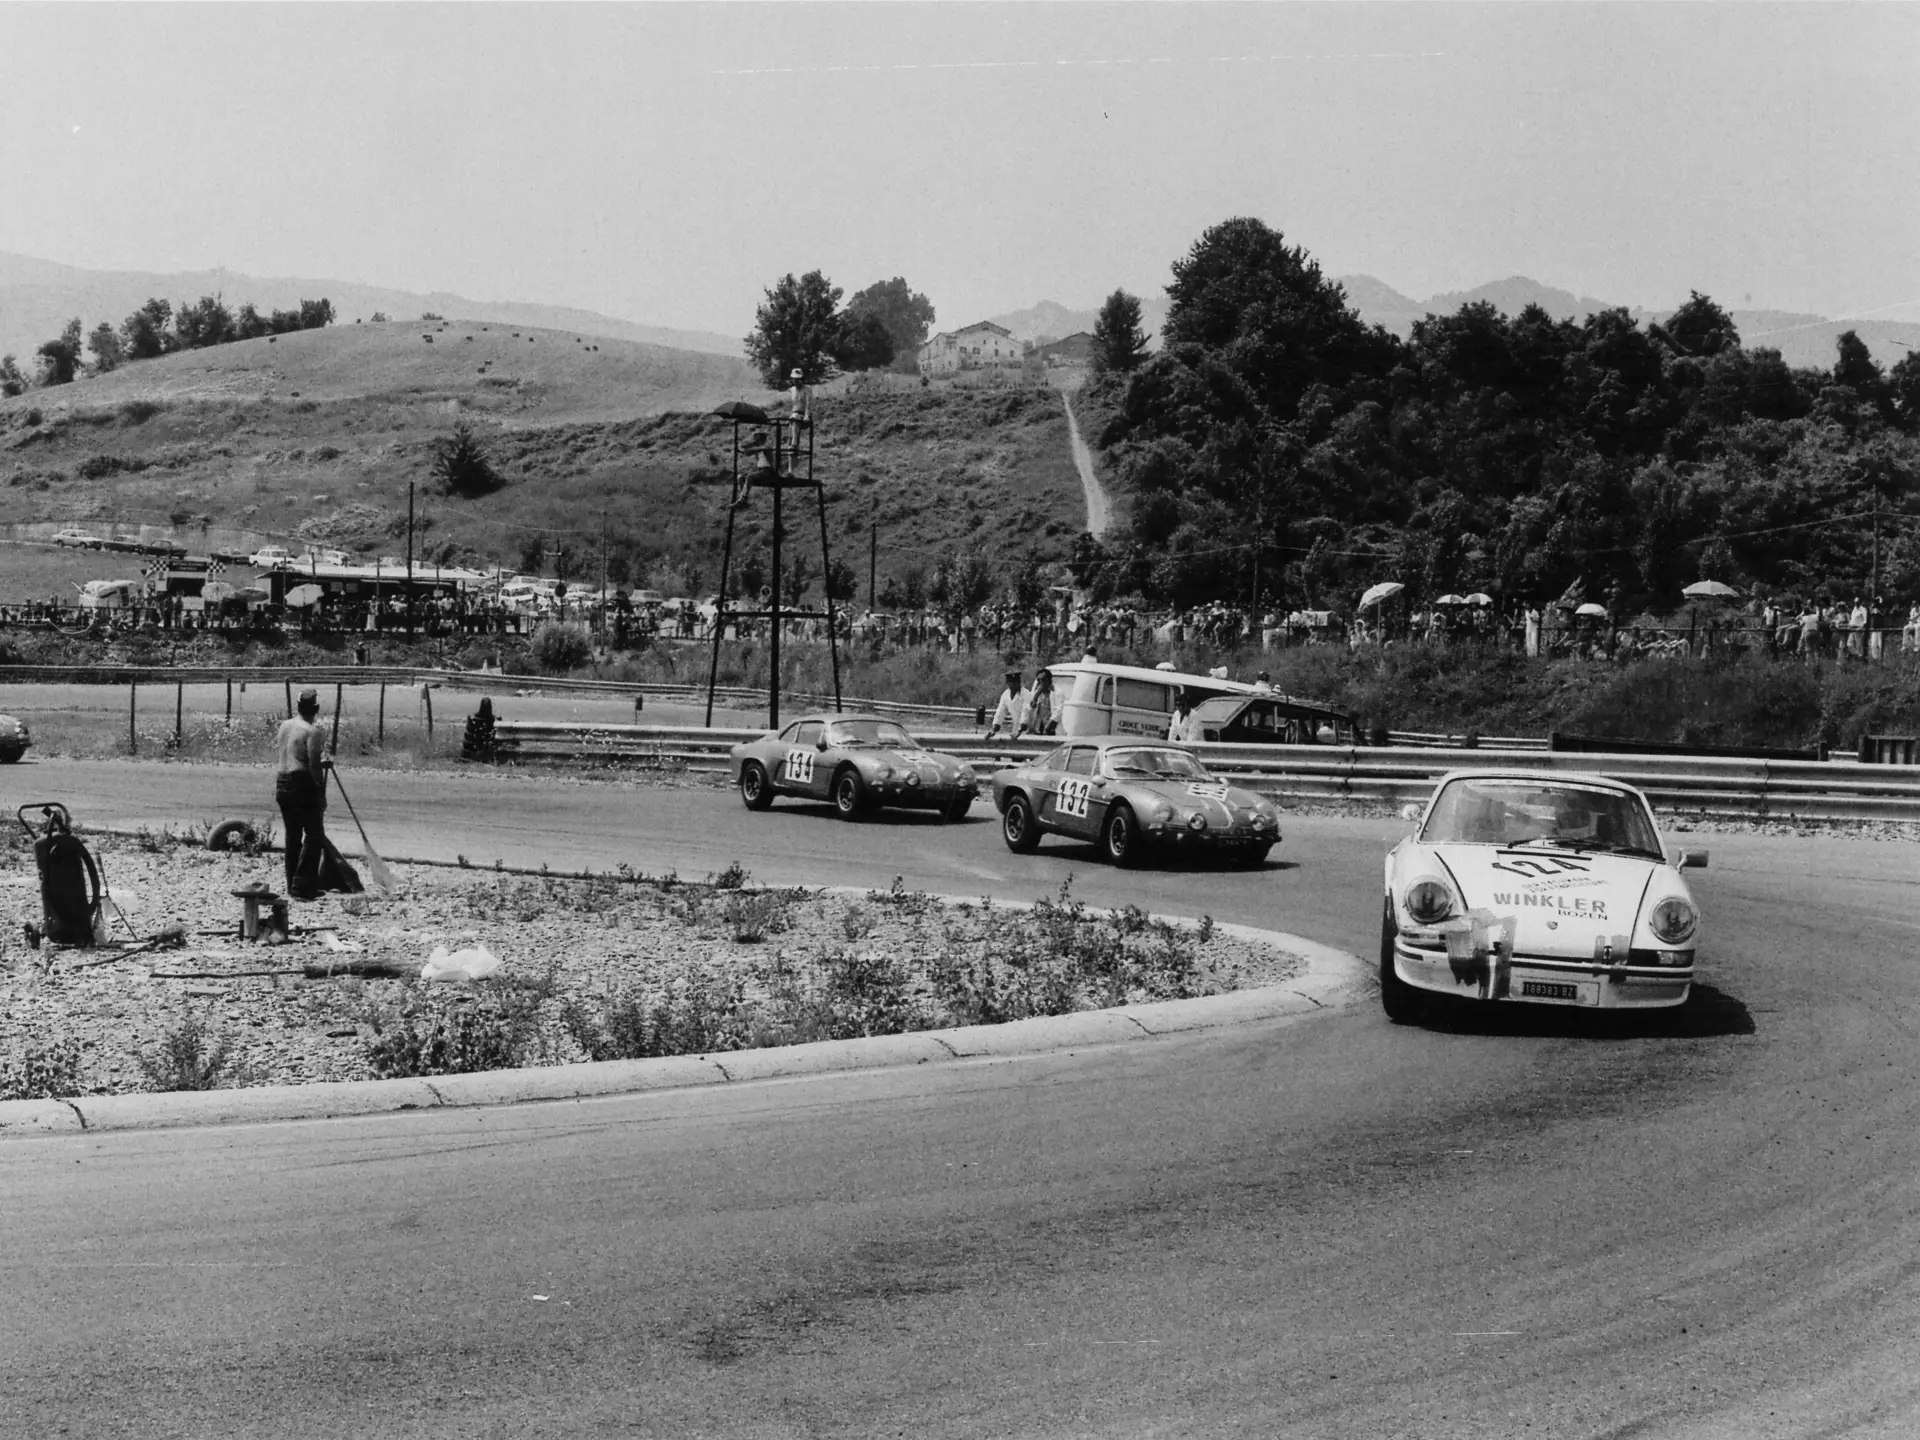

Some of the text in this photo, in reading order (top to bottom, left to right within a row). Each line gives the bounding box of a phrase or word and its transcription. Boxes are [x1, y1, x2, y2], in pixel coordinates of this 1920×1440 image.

[789, 752, 812, 781] 134
[1060, 780, 1089, 815] 132
[1491, 858, 1590, 878] 124
[1493, 893, 1606, 913] WINKLER
[1557, 909, 1608, 921] BOZEN
